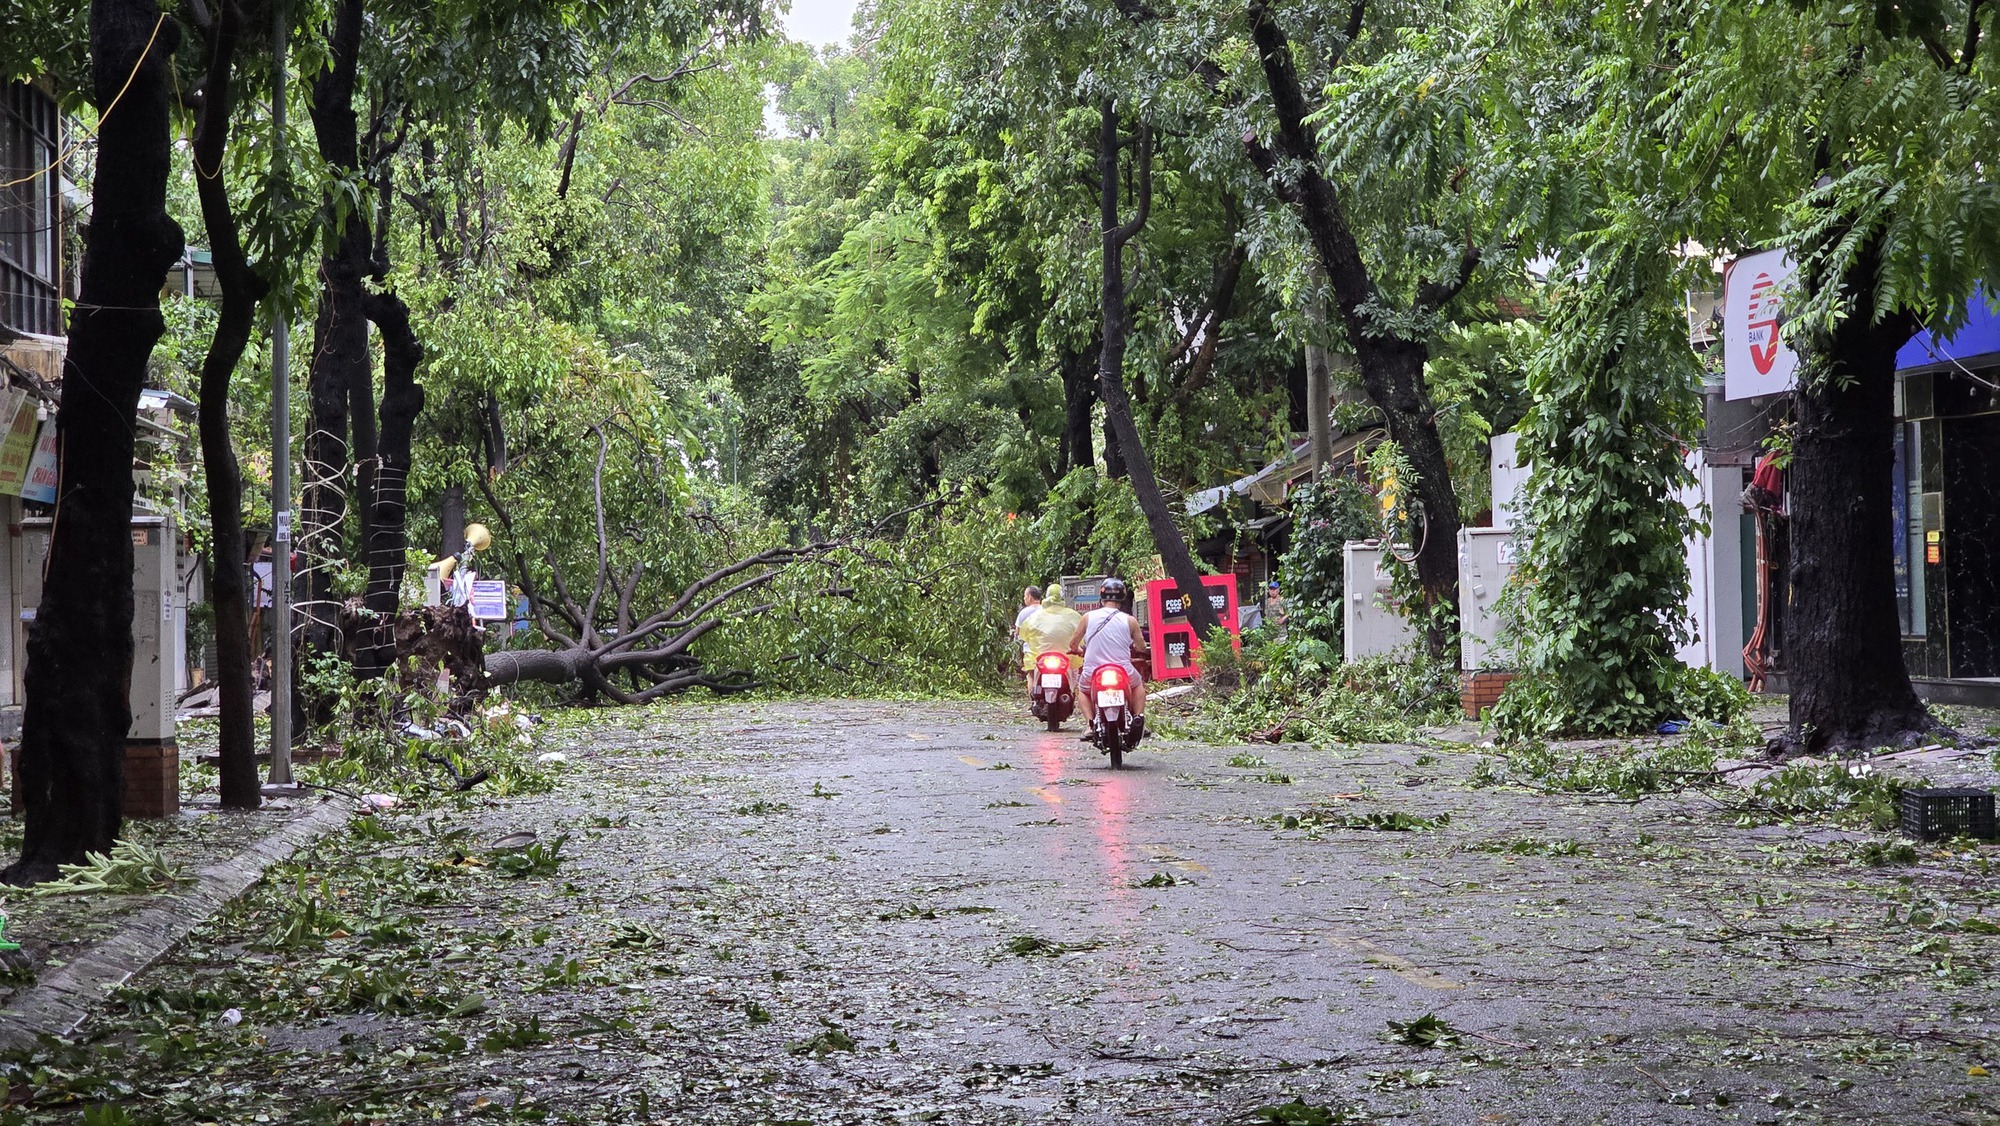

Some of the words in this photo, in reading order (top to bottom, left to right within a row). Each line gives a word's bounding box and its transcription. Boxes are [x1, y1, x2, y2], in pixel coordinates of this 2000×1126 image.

[1748, 330, 1765, 343] BANK
[1166, 599, 1182, 608] PCCC
[1169, 643, 1185, 652] PCCC
